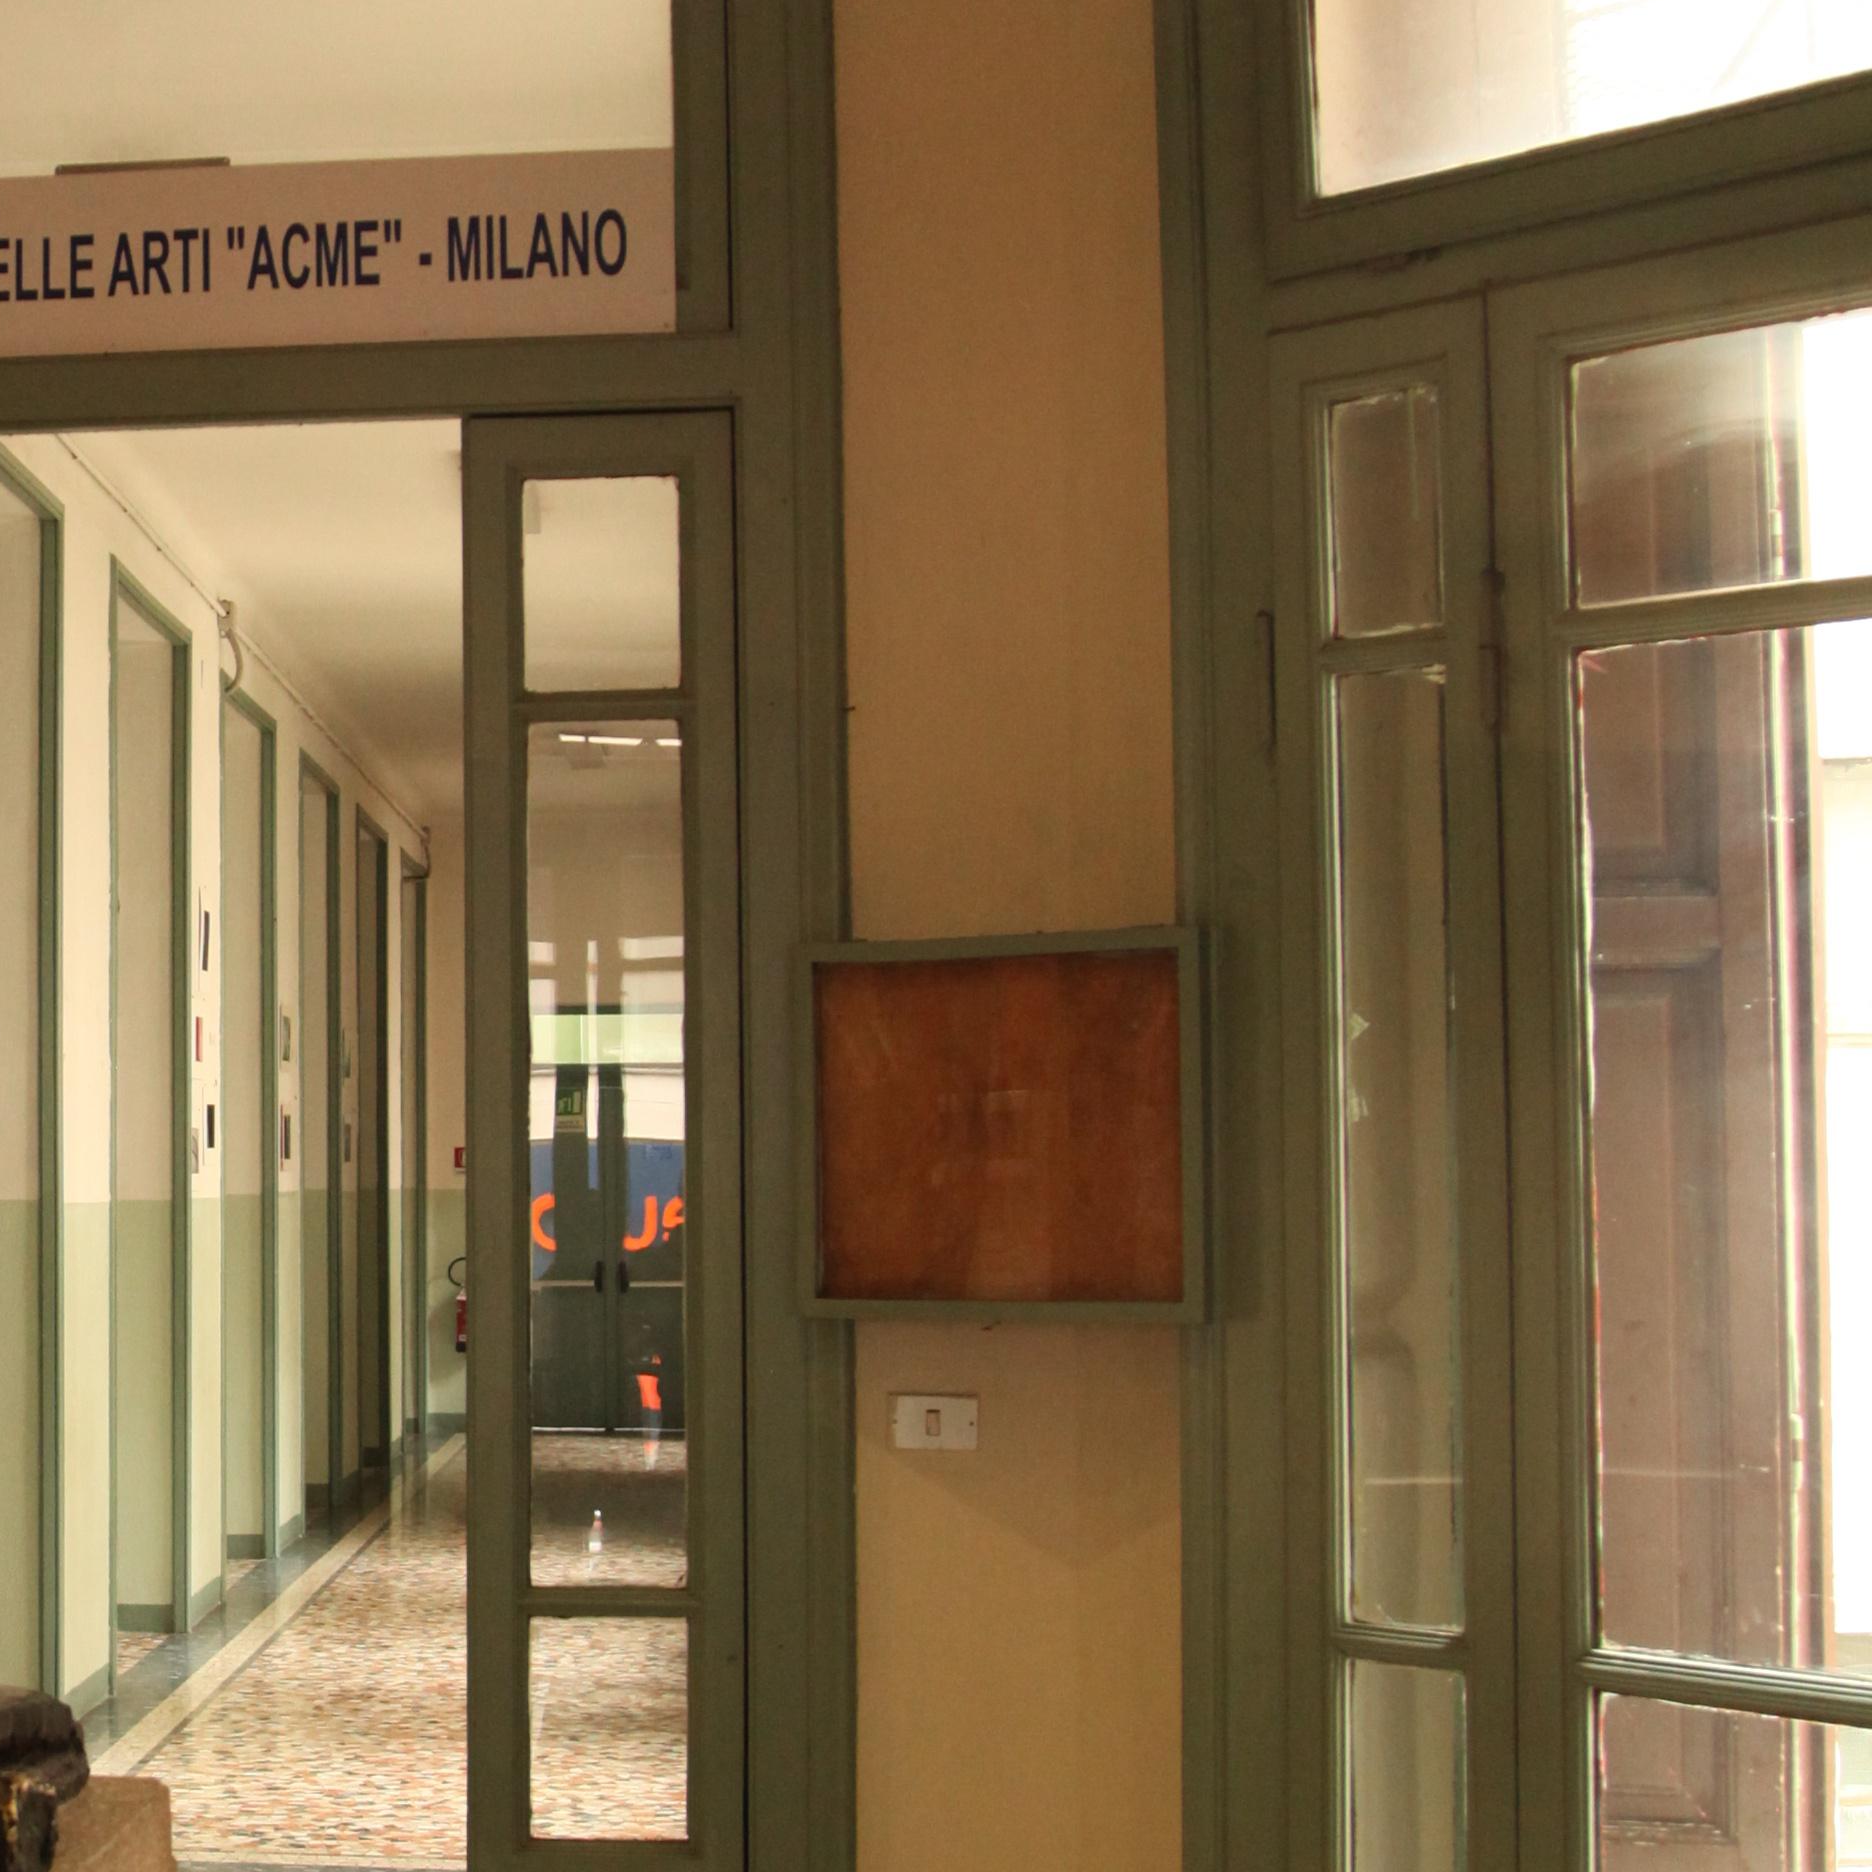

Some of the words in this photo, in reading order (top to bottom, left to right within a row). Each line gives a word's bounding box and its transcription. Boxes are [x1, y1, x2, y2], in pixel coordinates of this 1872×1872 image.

[107, 227, 211, 297] ARTI
[227, 218, 403, 291] "ACME"
[447, 208, 628, 282] MILANO
